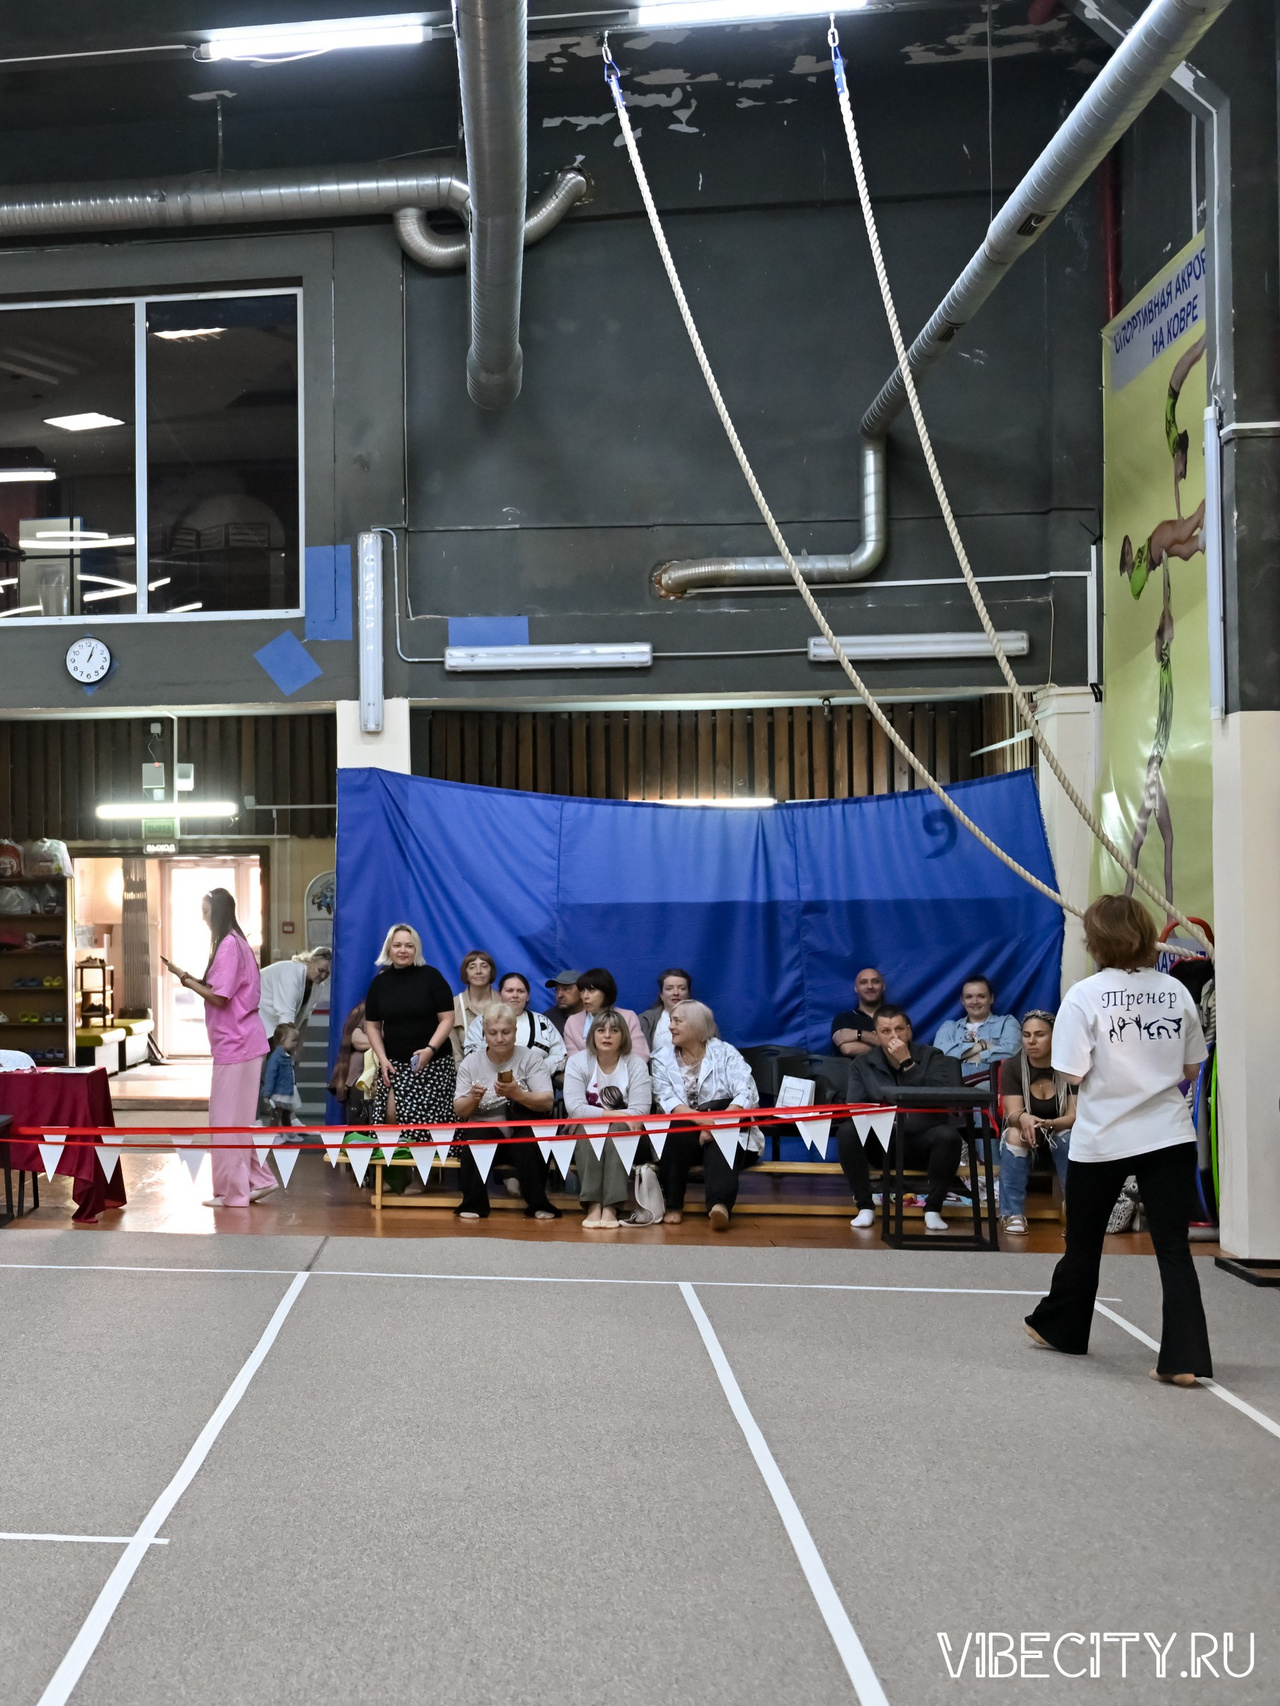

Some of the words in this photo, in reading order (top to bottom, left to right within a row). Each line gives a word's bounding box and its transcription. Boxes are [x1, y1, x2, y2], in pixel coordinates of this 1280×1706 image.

[1114, 280, 1173, 354] СПОРТИВНАЯ
[1151, 333, 1165, 358] НА
[1166, 294, 1199, 345] КОВРЕ
[1101, 988, 1177, 1011] Тренер
